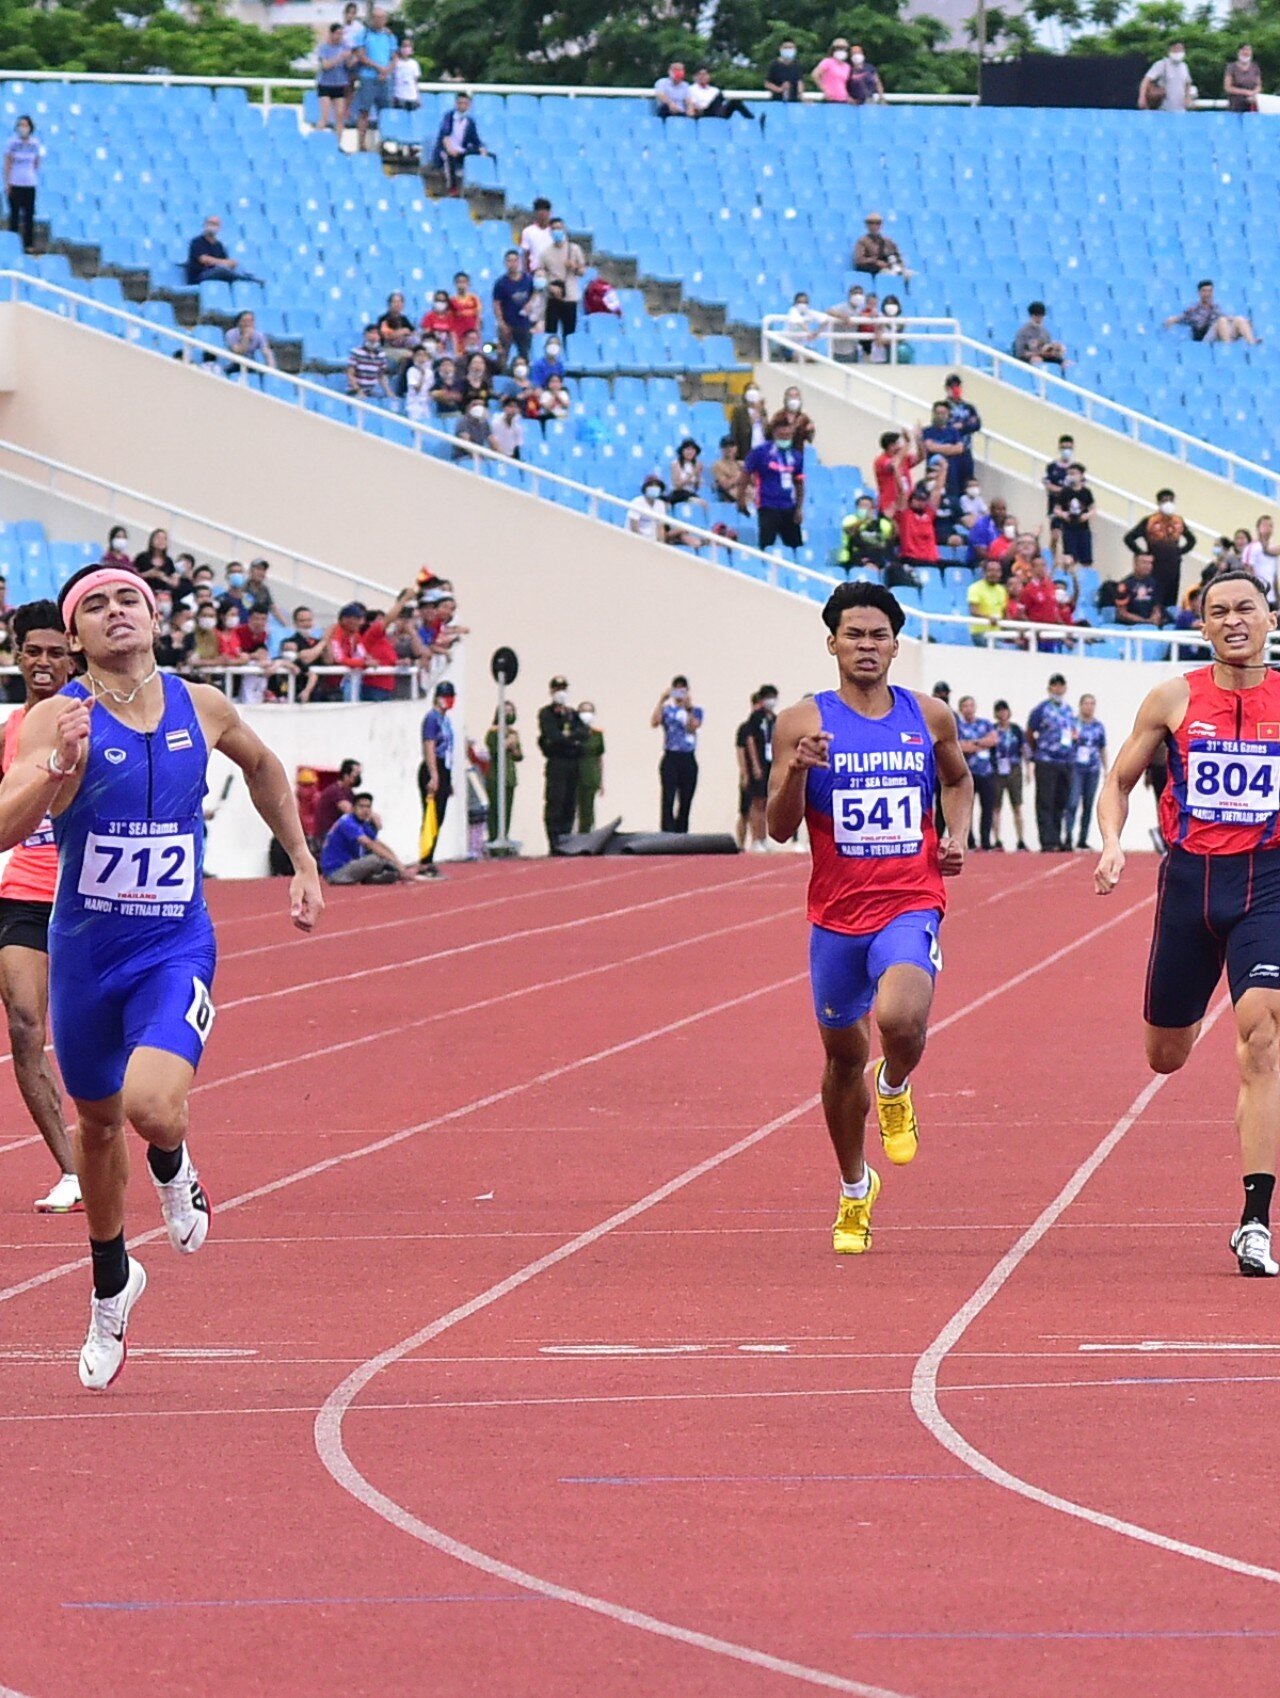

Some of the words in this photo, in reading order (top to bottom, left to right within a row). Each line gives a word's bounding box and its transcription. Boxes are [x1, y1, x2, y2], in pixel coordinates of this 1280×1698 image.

[1222, 741, 1239, 753] SEA
[1240, 742, 1267, 754] Games
[833, 751, 925, 773] PILIPINAS
[864, 776, 881, 788] SEA
[881, 776, 908, 787] Games
[1195, 760, 1274, 798] 804
[842, 795, 911, 832] 541
[1221, 810, 1254, 822] VIETNAM
[128, 821, 149, 836] SEA
[149, 821, 179, 835] Games
[870, 843, 901, 855] VIETNAM
[94, 844, 186, 888] 712
[117, 892, 157, 900] THAILAND
[83, 897, 113, 913] HANOI
[120, 903, 160, 917] VIETNAM
[161, 904, 185, 917] 2022
[196, 989, 210, 1031] 6
